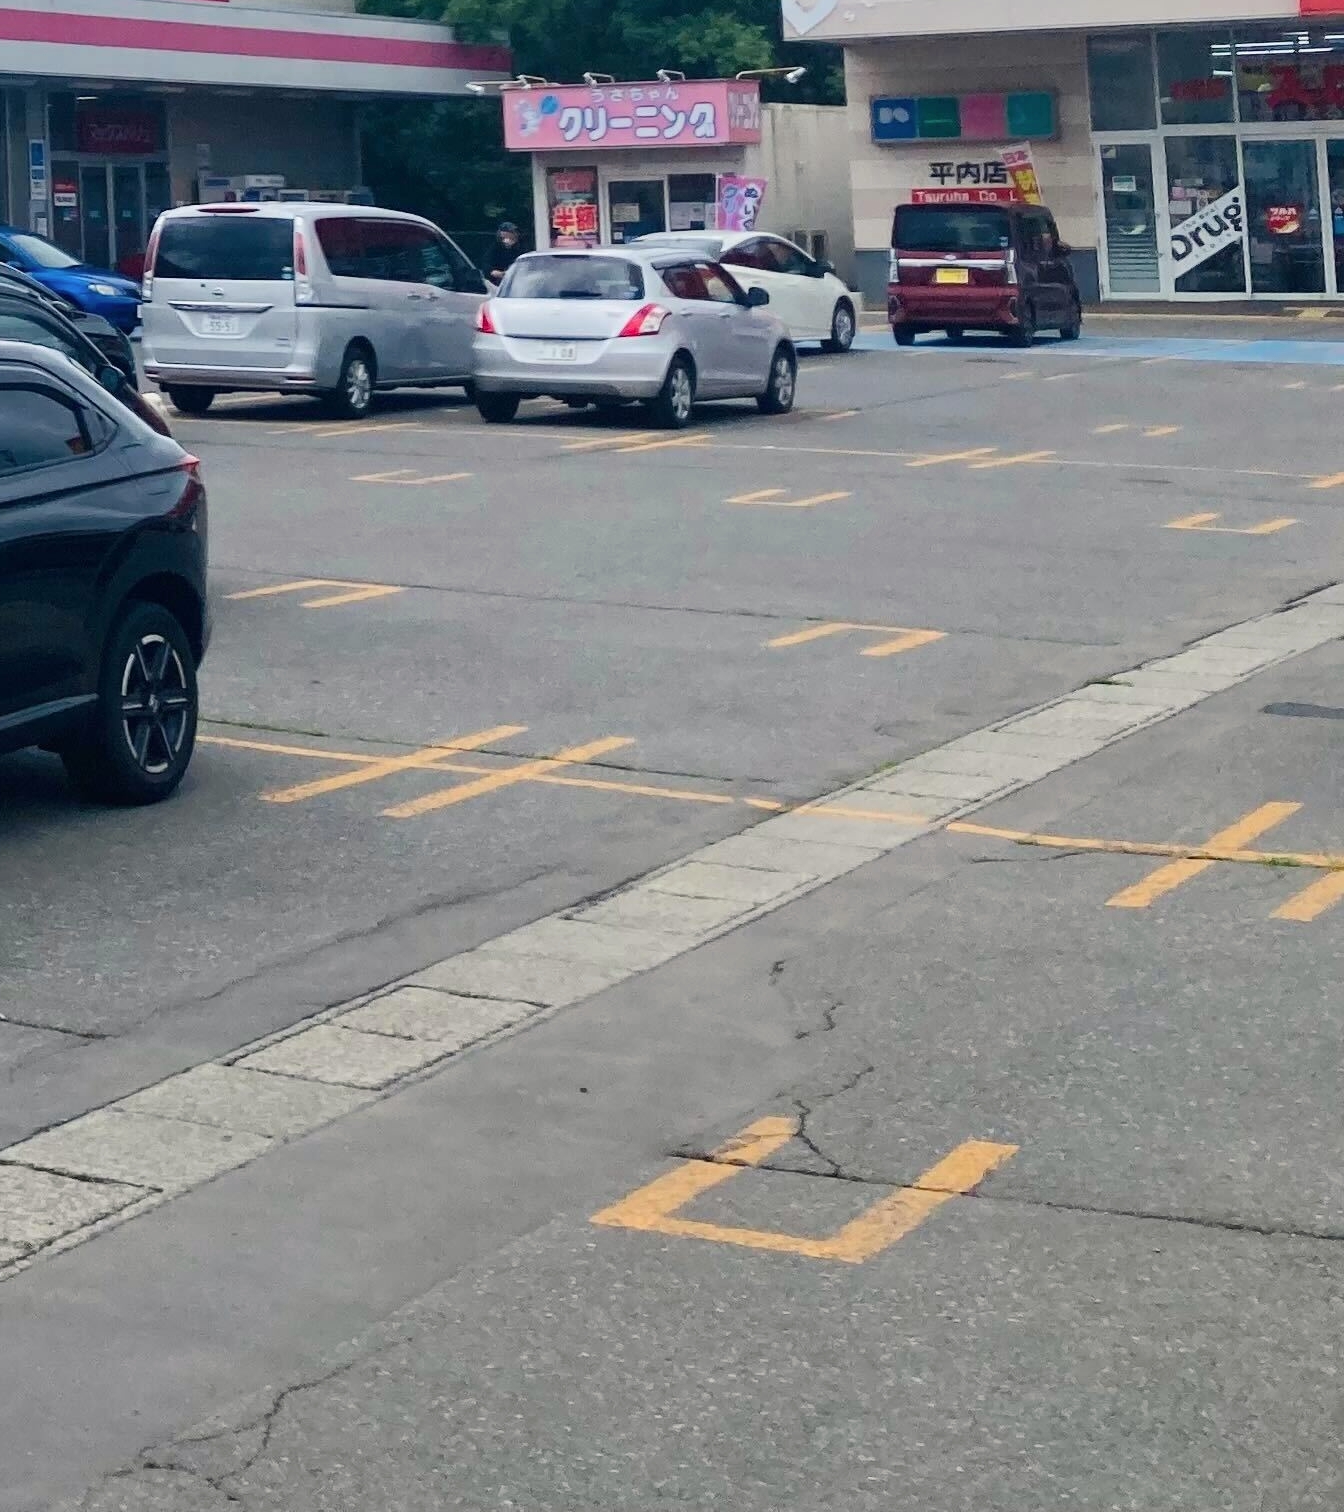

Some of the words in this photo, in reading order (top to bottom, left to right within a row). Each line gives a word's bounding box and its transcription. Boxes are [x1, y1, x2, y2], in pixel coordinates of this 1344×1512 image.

[591, 88, 679, 102] うさちゃん
[559, 102, 716, 141] クリーニング
[929, 161, 1008, 185] 平内店
